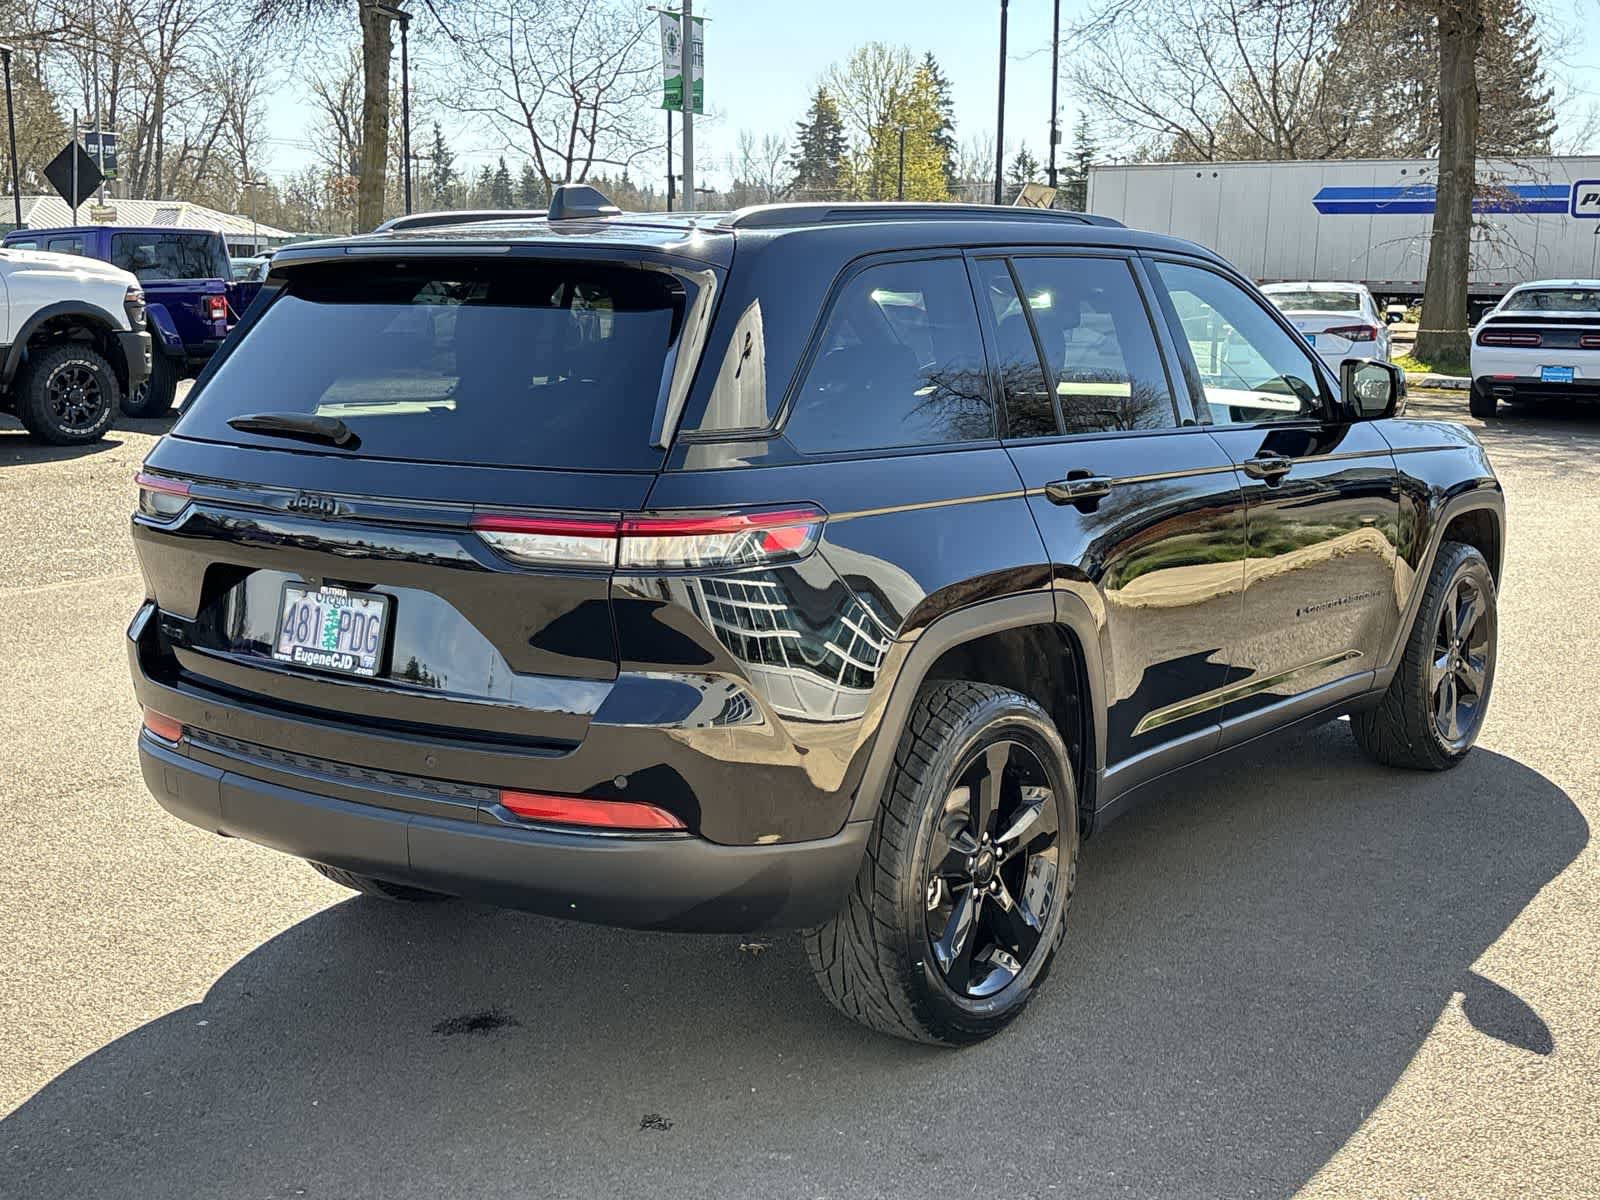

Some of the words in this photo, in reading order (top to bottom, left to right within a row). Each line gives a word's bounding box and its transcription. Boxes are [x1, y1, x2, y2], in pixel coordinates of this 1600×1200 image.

[287, 493, 337, 518] Jeep
[316, 592, 353, 609] Oregon
[284, 602, 321, 646] 481
[336, 610, 380, 653] PDG
[294, 646, 353, 669] EugeneCJD
